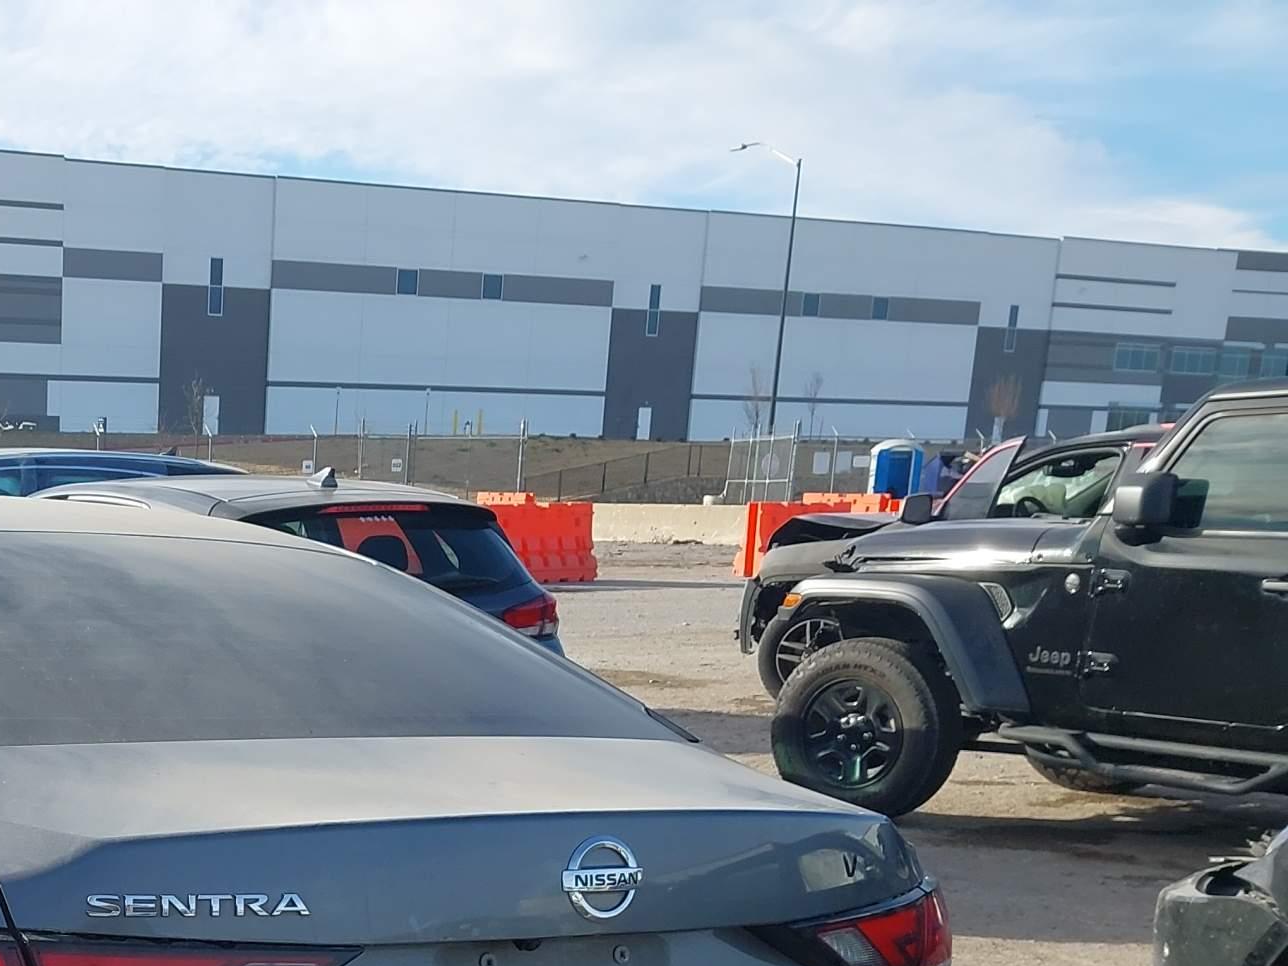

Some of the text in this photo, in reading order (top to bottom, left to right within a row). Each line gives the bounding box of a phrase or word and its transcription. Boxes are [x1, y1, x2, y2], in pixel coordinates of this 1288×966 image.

[1028, 645, 1072, 667] Jeep
[574, 870, 639, 888] NISSAN
[86, 893, 312, 917] SENTRA
